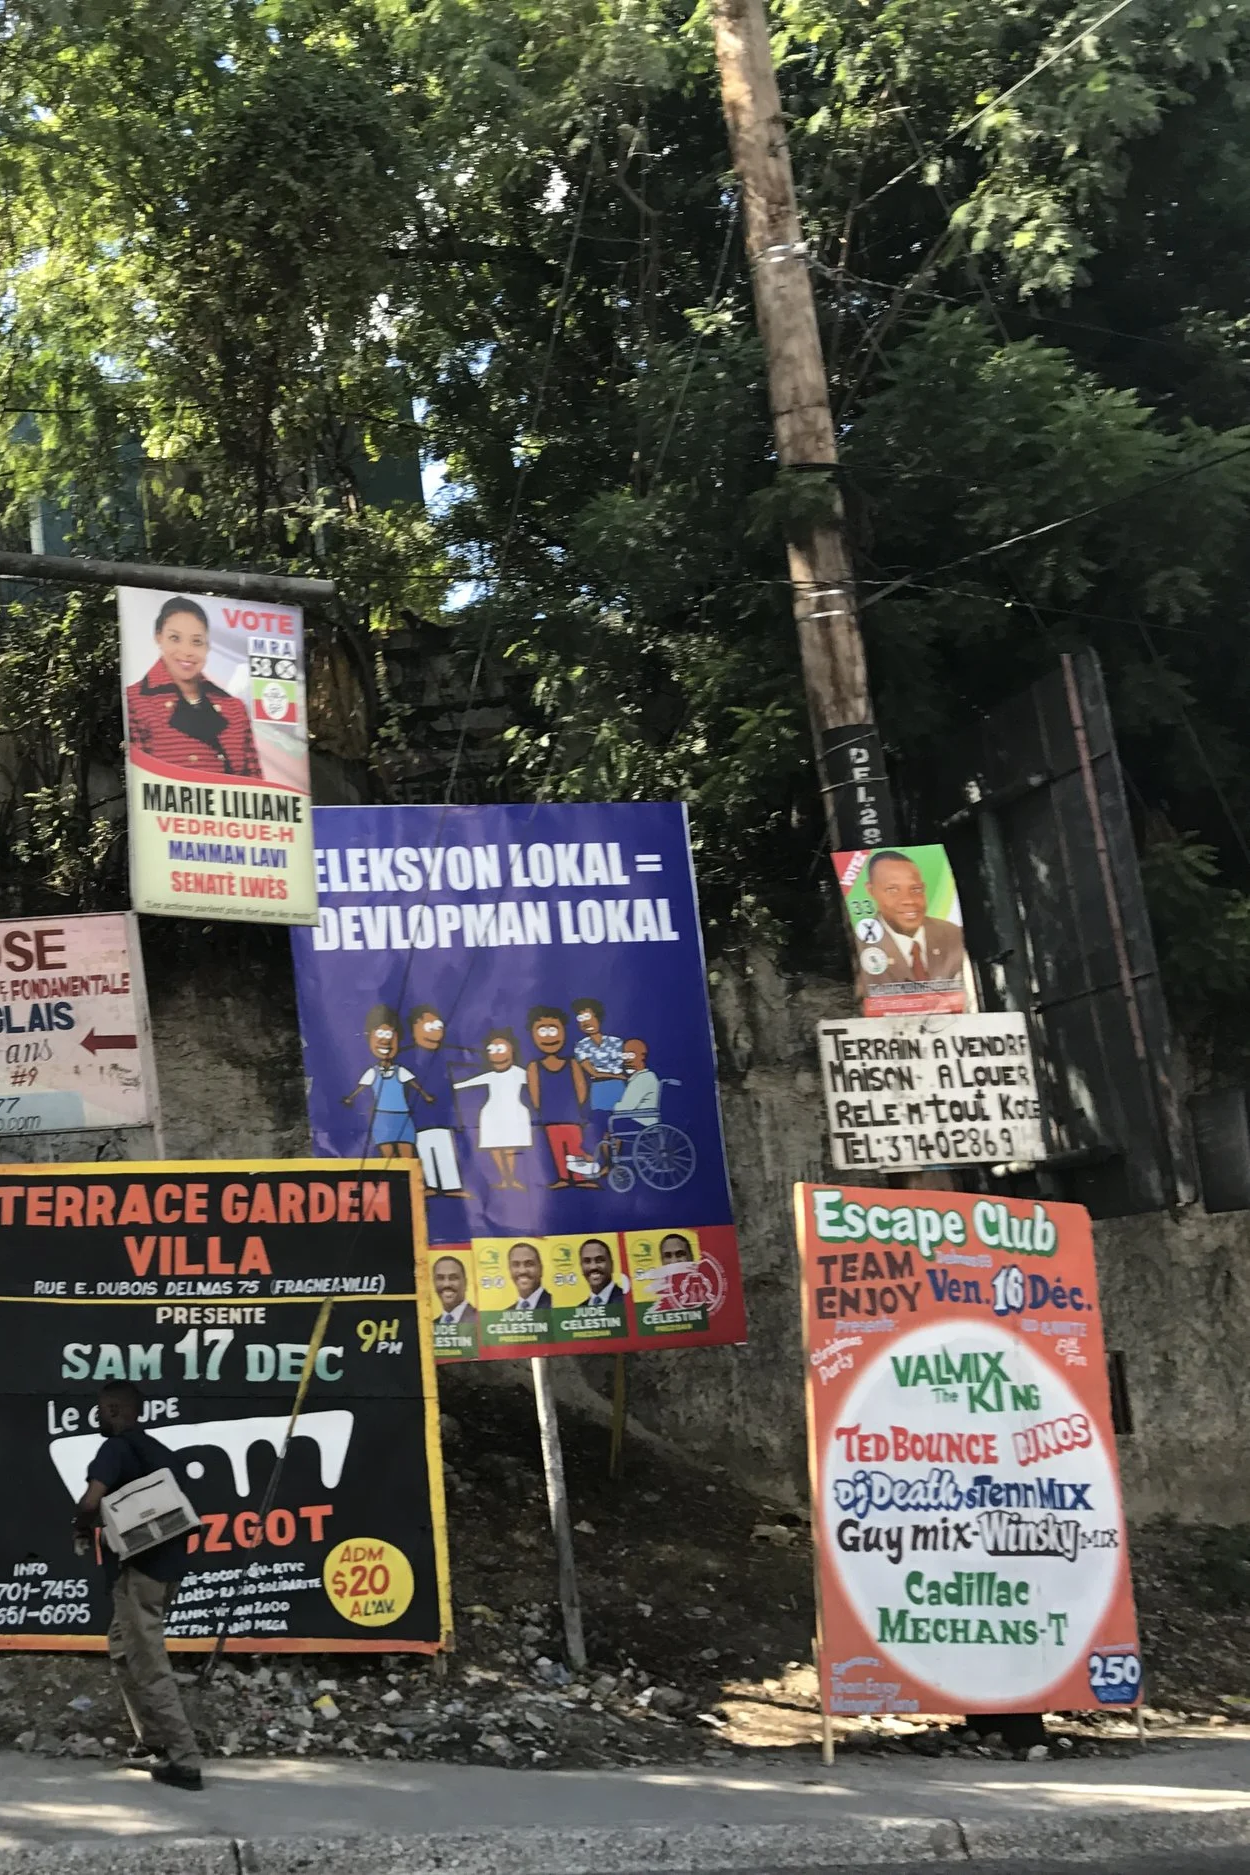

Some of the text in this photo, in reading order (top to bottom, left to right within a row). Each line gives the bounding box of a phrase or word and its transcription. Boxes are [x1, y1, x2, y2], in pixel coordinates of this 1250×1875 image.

[222, 608, 294, 634] VOTE
[142, 783, 302, 823] MARIE LILIANE
[156, 816, 294, 842] VEDRIGUE-H
[168, 840, 287, 868] MANMAN LAVI
[315, 844, 505, 892] ELEKSYON
[509, 841, 630, 888] LOKAL
[313, 899, 680, 951] DEVLOPMAN LOKAL
[11, 972, 130, 1000] FONDAMENTALE
[5, 1037, 53, 1063] ans
[933, 1038, 949, 1059] A
[938, 1064, 953, 1088] A
[956, 1059, 1029, 1088] LOUER
[221, 1181, 391, 1224] GARDEN
[813, 1189, 1058, 1260] Escape Club
[124, 1236, 272, 1276] VILLA
[817, 1252, 914, 1285] TEAM
[34, 1280, 67, 1295] RUE
[165, 1280, 233, 1296] DELMAS
[238, 1280, 260, 1295] 75
[816, 1282, 921, 1319] ENJOY
[927, 1265, 1093, 1316] Ven. 16 Déc.
[156, 1306, 266, 1325] PRESENTE
[487, 1322, 548, 1334] CELESTIN
[501, 1311, 534, 1322] JUDE
[560, 1317, 621, 1330] CELESTIN
[573, 1306, 606, 1318] JUDE
[642, 1310, 703, 1325] CELESTIN
[62, 1328, 344, 1381] SAM 17 DEC
[376, 1341, 403, 1356] PM
[891, 1345, 1012, 1388] VALMIX
[931, 1377, 1041, 1413] The KING
[47, 1400, 79, 1435] Le
[340, 1546, 384, 1563] ADM
[837, 1518, 903, 1564] Guy
[14, 1562, 48, 1577] INFO
[332, 1564, 390, 1599] $20
[905, 1571, 1030, 1607] Cadillac
[877, 1607, 1069, 1646] MECHANS-T
[1089, 1654, 1142, 1687] 250
